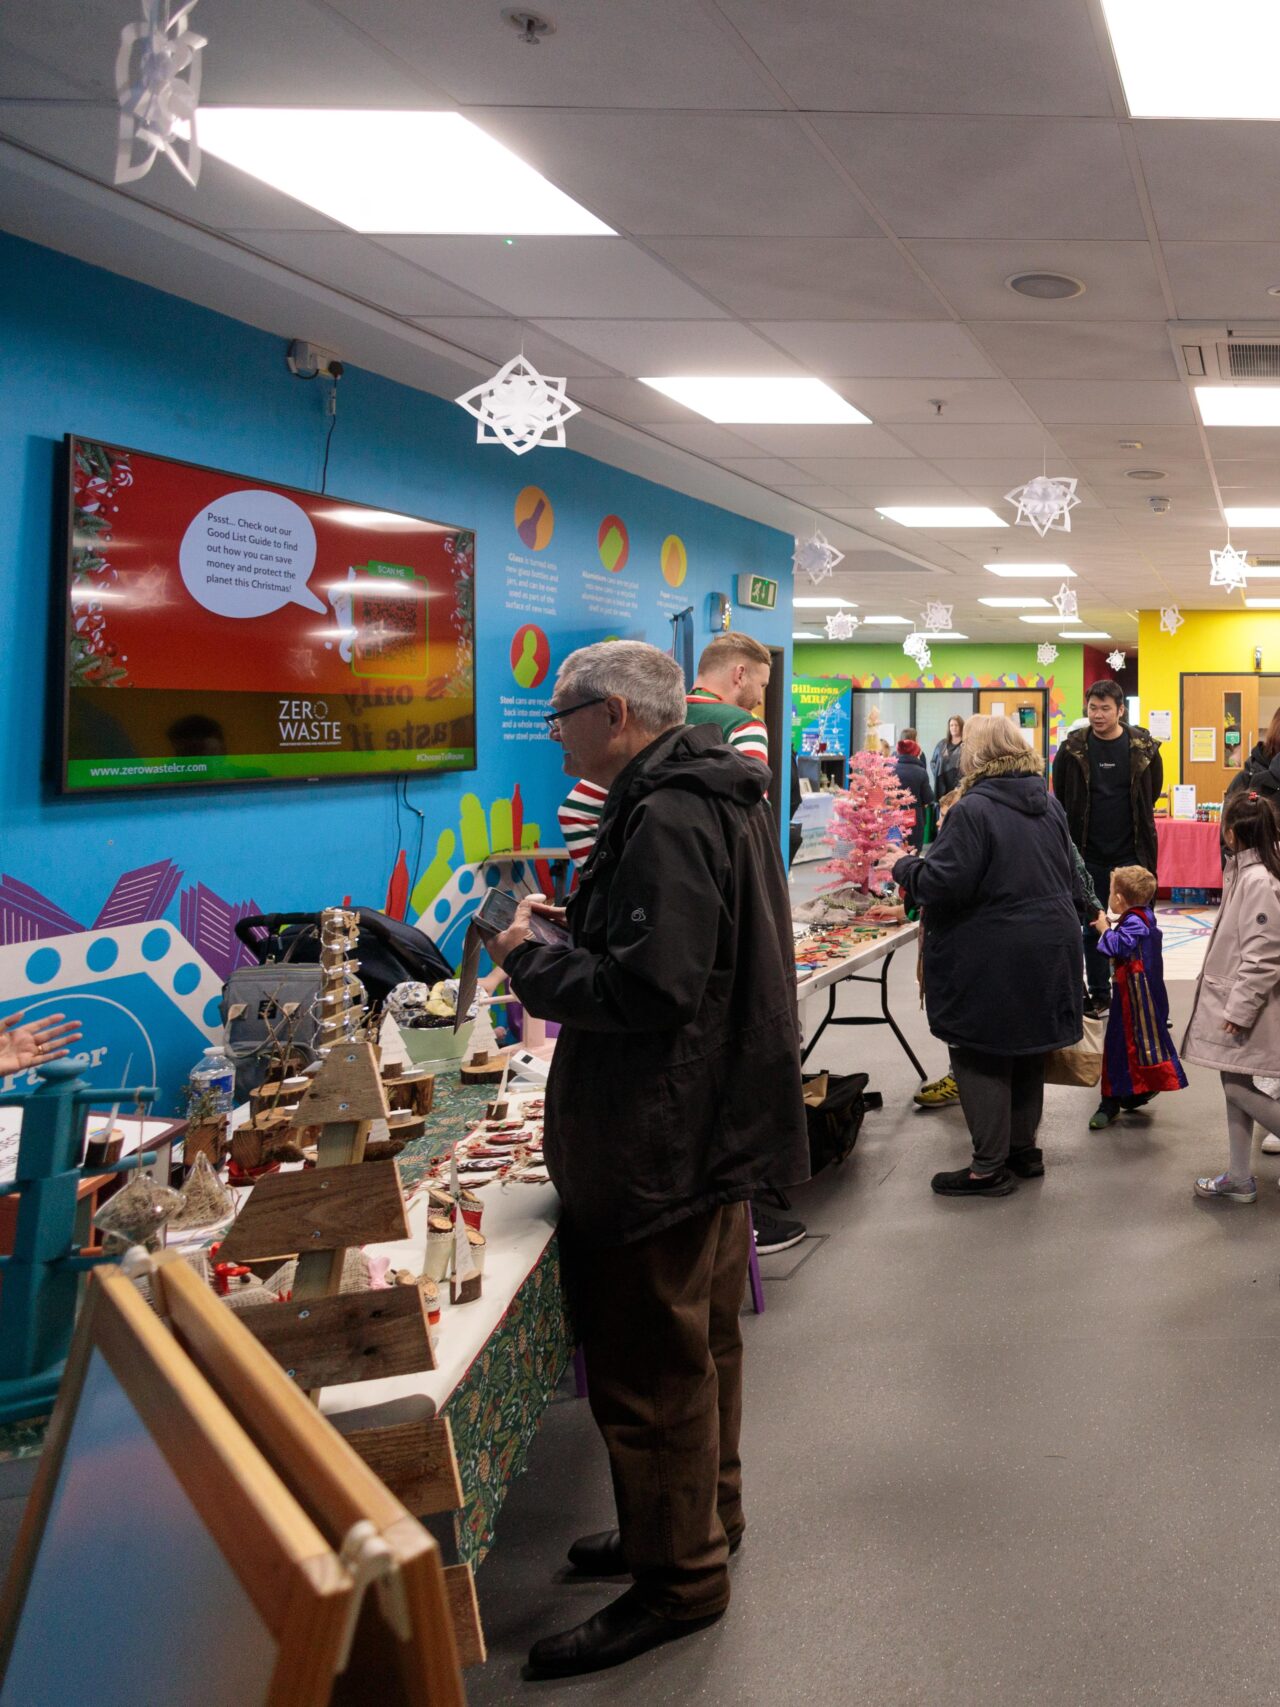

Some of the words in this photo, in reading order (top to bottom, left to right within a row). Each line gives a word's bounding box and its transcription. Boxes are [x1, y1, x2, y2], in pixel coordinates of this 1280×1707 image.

[238, 518, 262, 531] Check
[264, 525, 277, 534] out
[279, 528, 292, 536] our
[207, 527, 230, 539] Good
[232, 532, 247, 542] List
[249, 535, 271, 547] Guide
[273, 540, 281, 549] to
[283, 541, 298, 551] find
[207, 545, 221, 554] out
[223, 545, 241, 556] how
[243, 550, 258, 560] you
[260, 553, 273, 561] can
[275, 556, 293, 565] save
[508, 552, 524, 563] Glass
[207, 560, 235, 572] money
[237, 564, 252, 573] and
[254, 567, 282, 578] protect
[283, 570, 296, 579] the
[207, 574, 232, 586] planet
[235, 577, 249, 587] this
[251, 579, 292, 592] Christmas!
[792, 683, 839, 695] Gillmoss
[500, 695, 515, 705] Steel
[800, 694, 828, 704] MRF
[279, 701, 328, 720] ZERO
[279, 722, 341, 740] WASTE
[90, 763, 207, 776] www.zerowastelcr.com
